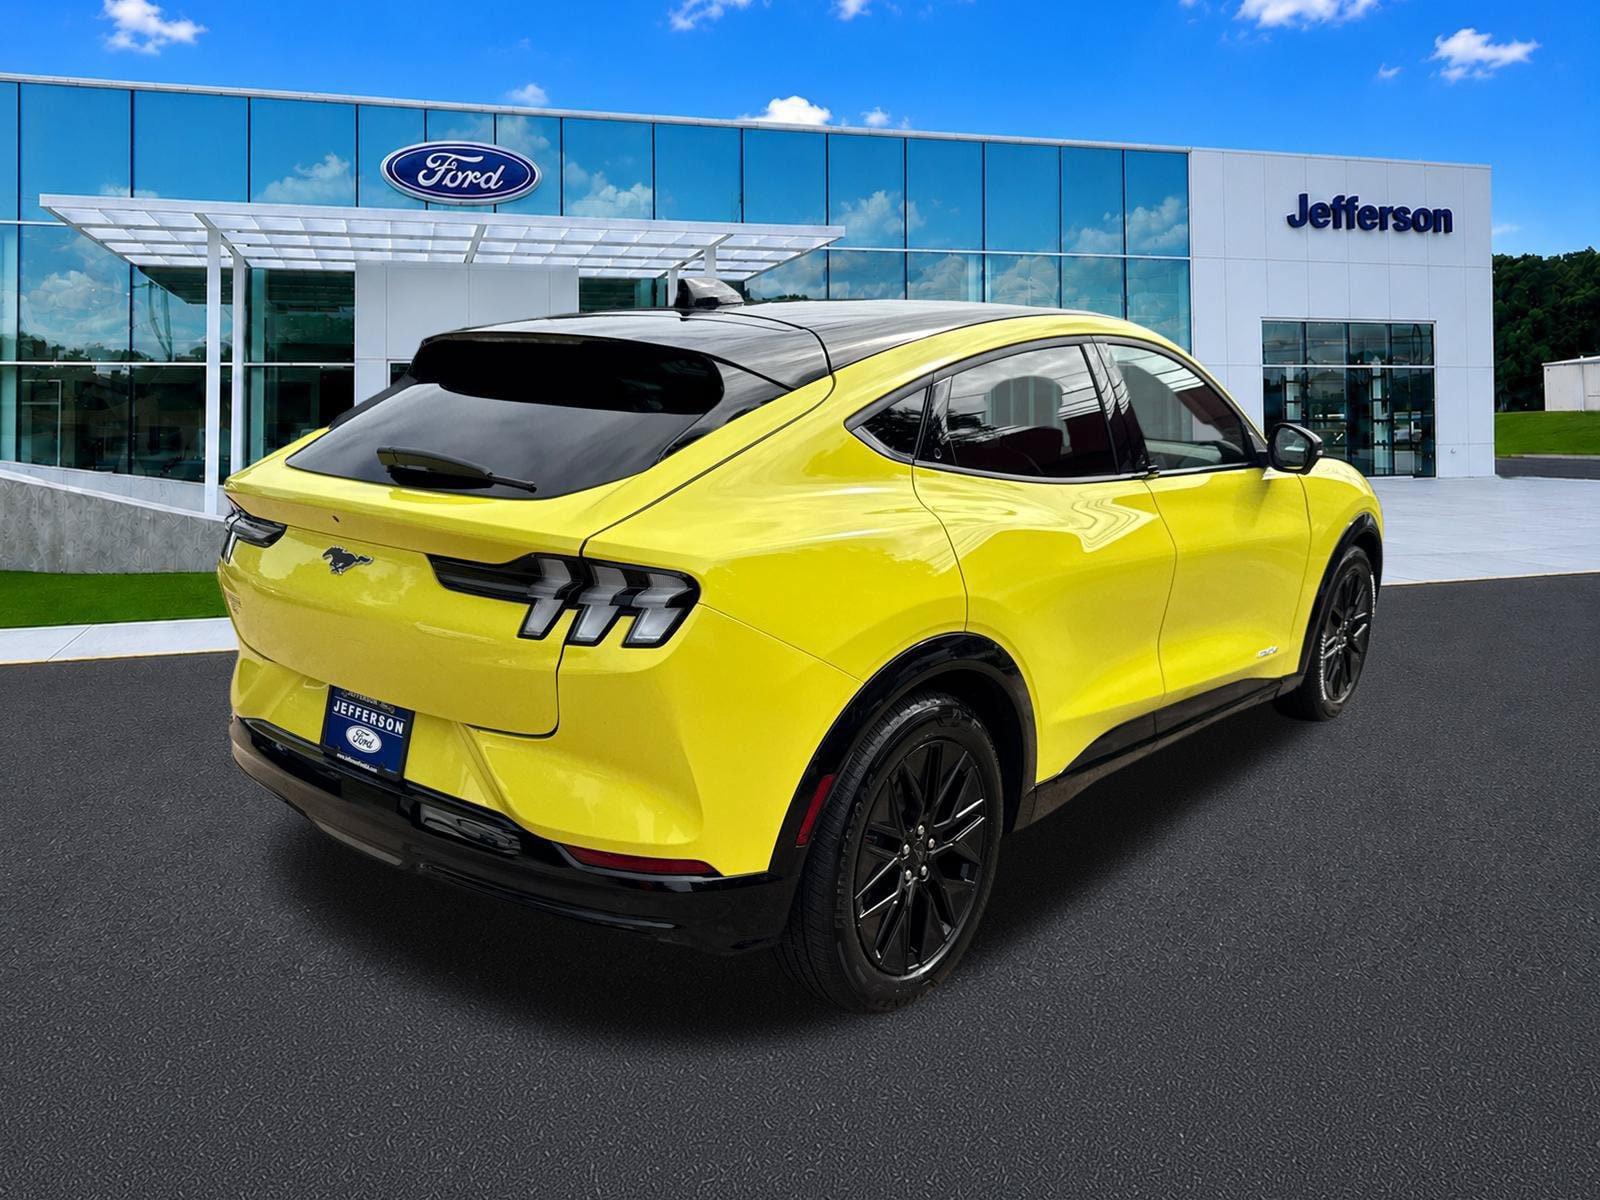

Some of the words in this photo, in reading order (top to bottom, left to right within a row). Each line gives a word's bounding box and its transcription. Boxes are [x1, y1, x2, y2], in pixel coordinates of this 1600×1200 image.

[417, 152, 506, 190] Ford
[1286, 193, 1453, 234] Jefferson
[333, 700, 404, 735] JEFFERSON
[352, 729, 375, 750] Ford
